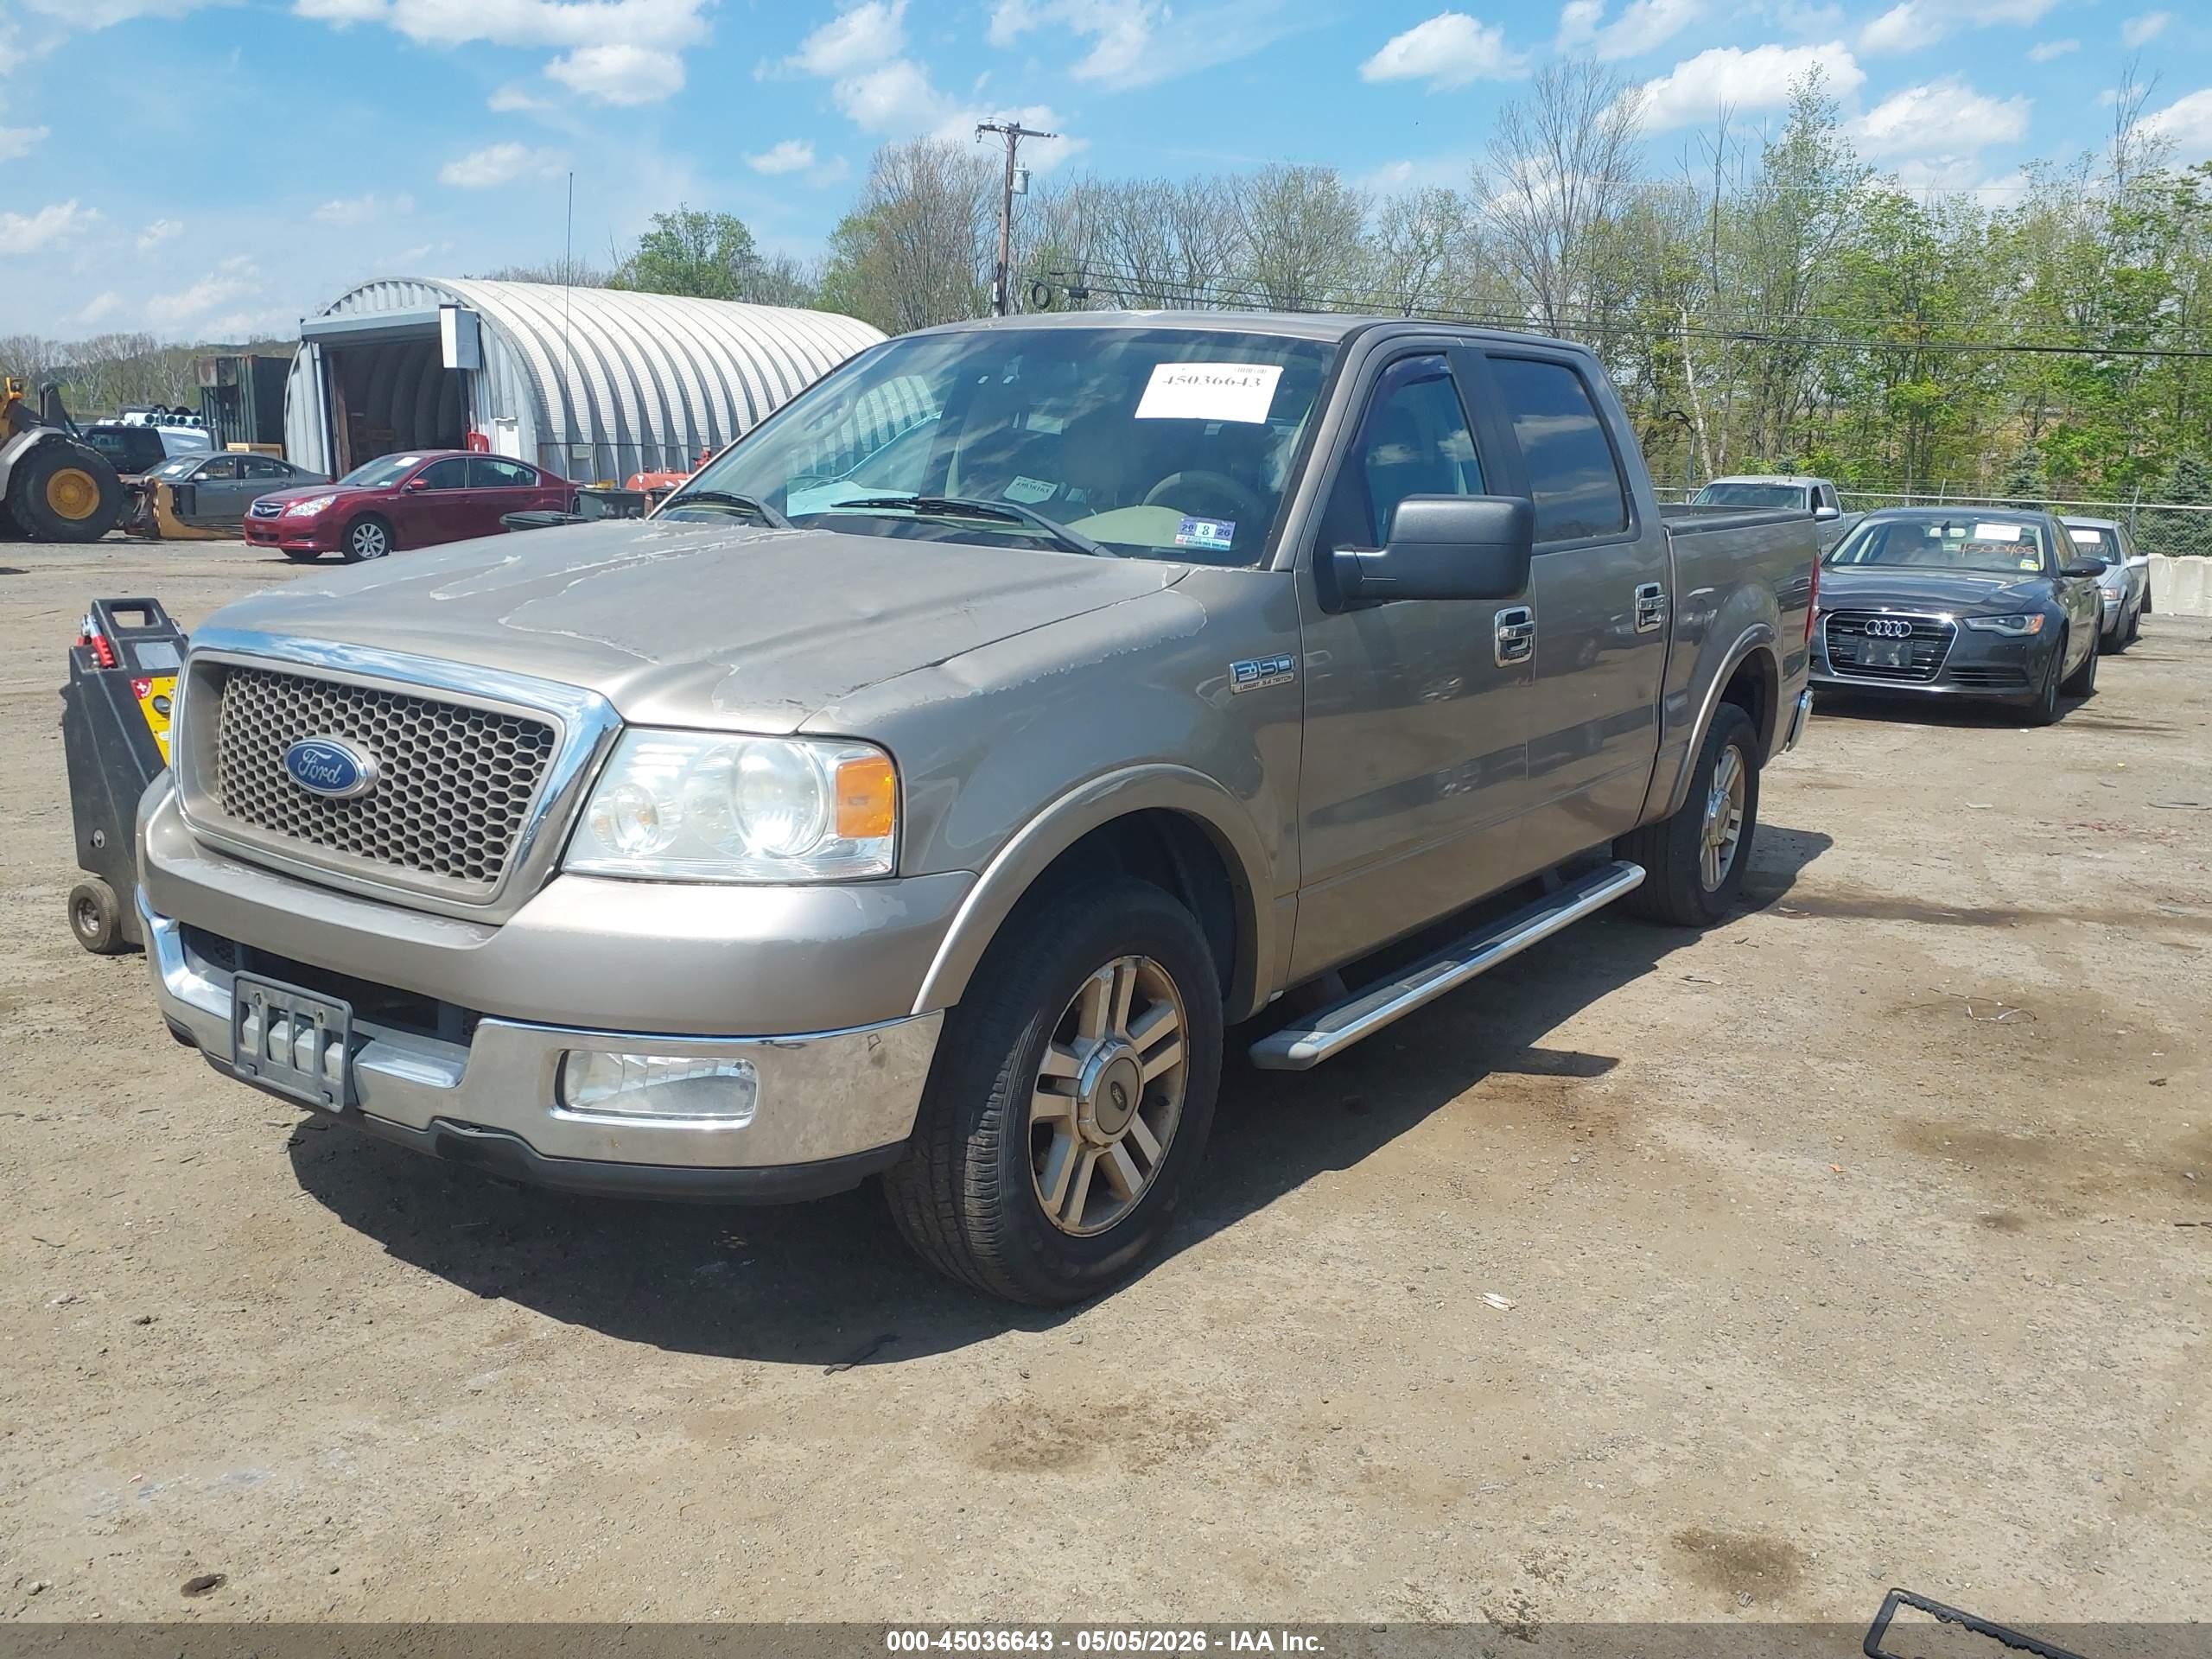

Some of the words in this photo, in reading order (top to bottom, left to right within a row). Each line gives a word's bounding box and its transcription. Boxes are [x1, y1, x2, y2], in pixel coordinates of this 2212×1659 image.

[1162, 375, 1261, 387] 45036643
[1202, 524, 1210, 536] 8
[1217, 528, 1230, 537] 26
[297, 748, 343, 784] Ford
